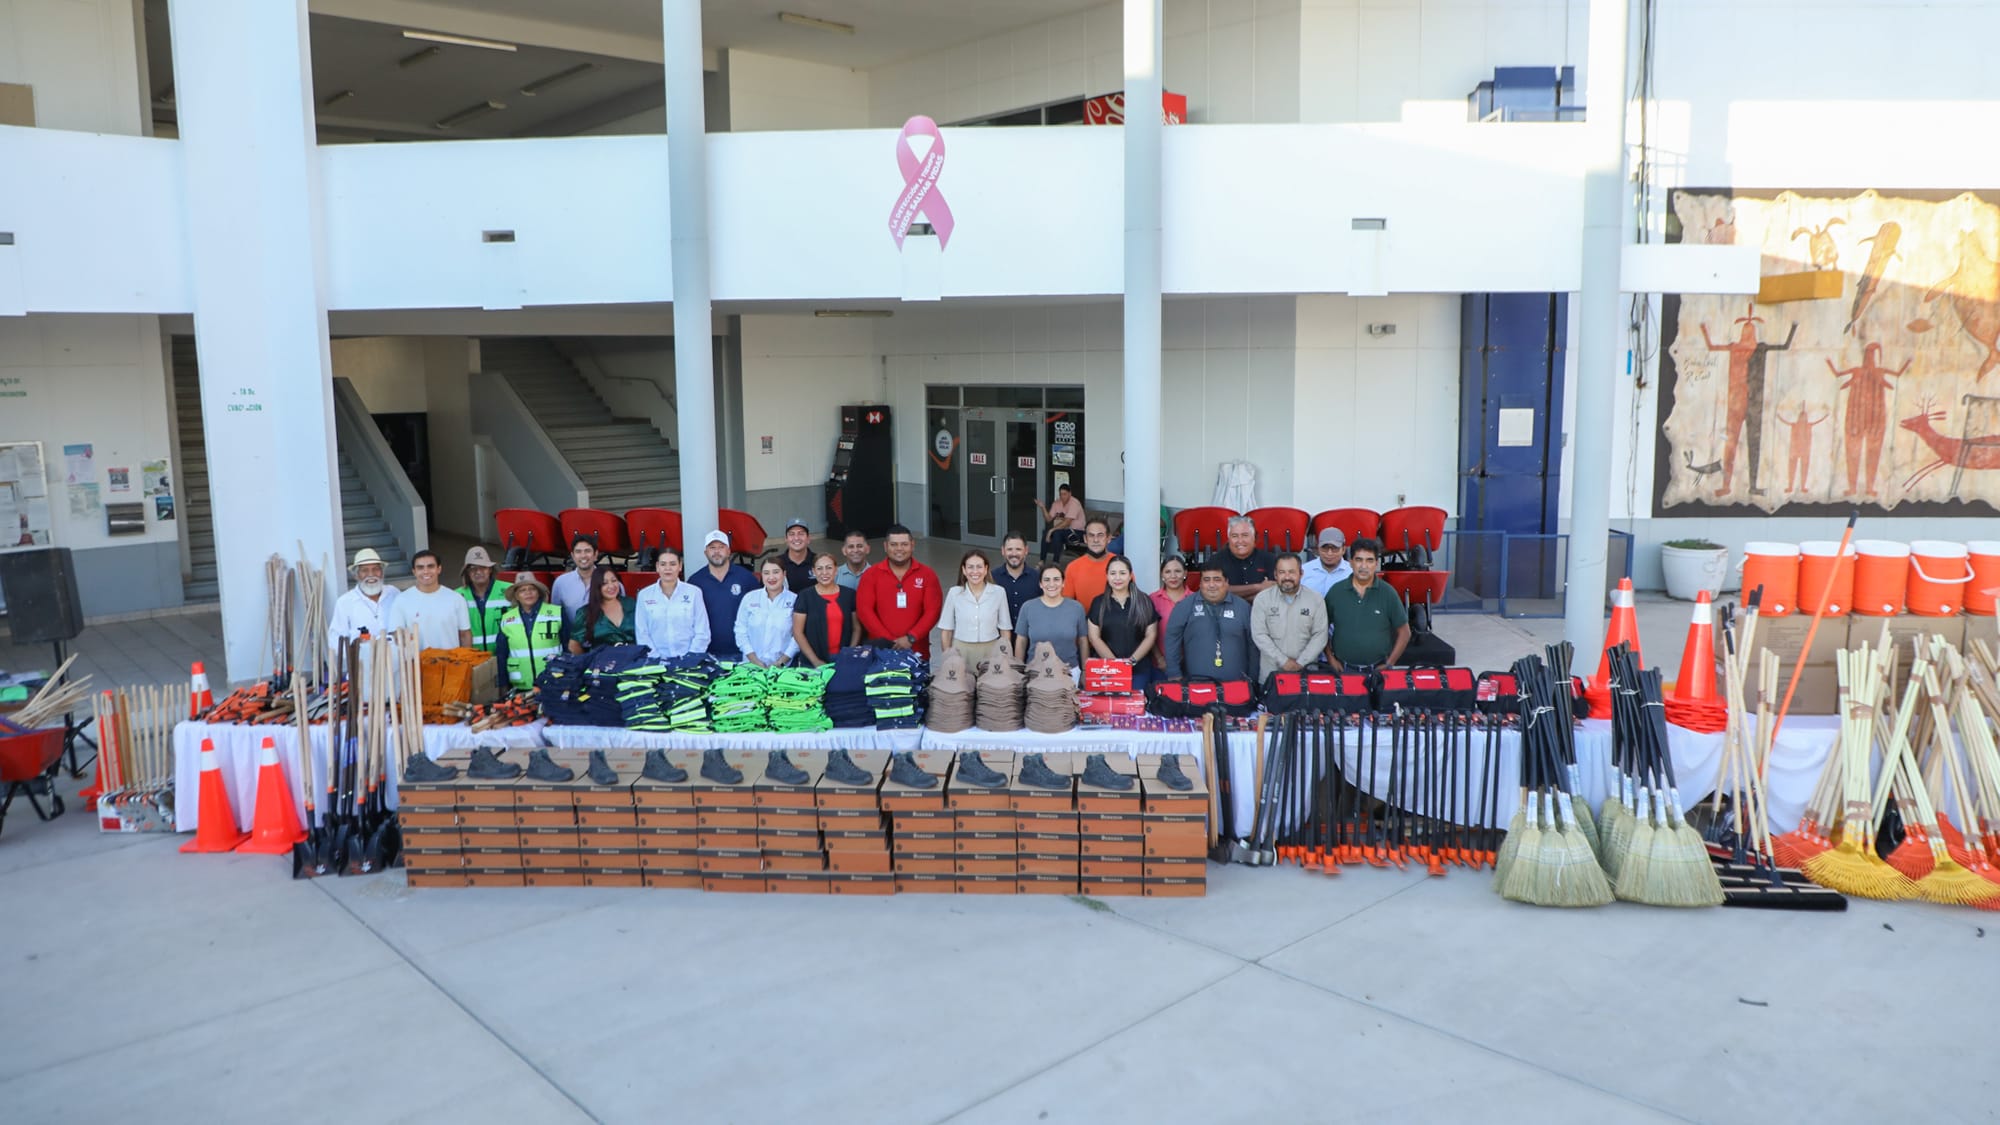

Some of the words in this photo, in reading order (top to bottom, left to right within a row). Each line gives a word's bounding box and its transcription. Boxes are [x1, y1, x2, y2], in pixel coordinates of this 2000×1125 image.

[891, 217, 899, 229] LA
[921, 152, 936, 178] TIEMPO
[896, 210, 913, 238] PUEDE
[909, 180, 932, 211] SALVAR
[929, 155, 944, 181] VIDAS
[1055, 421, 1076, 430] CERO
